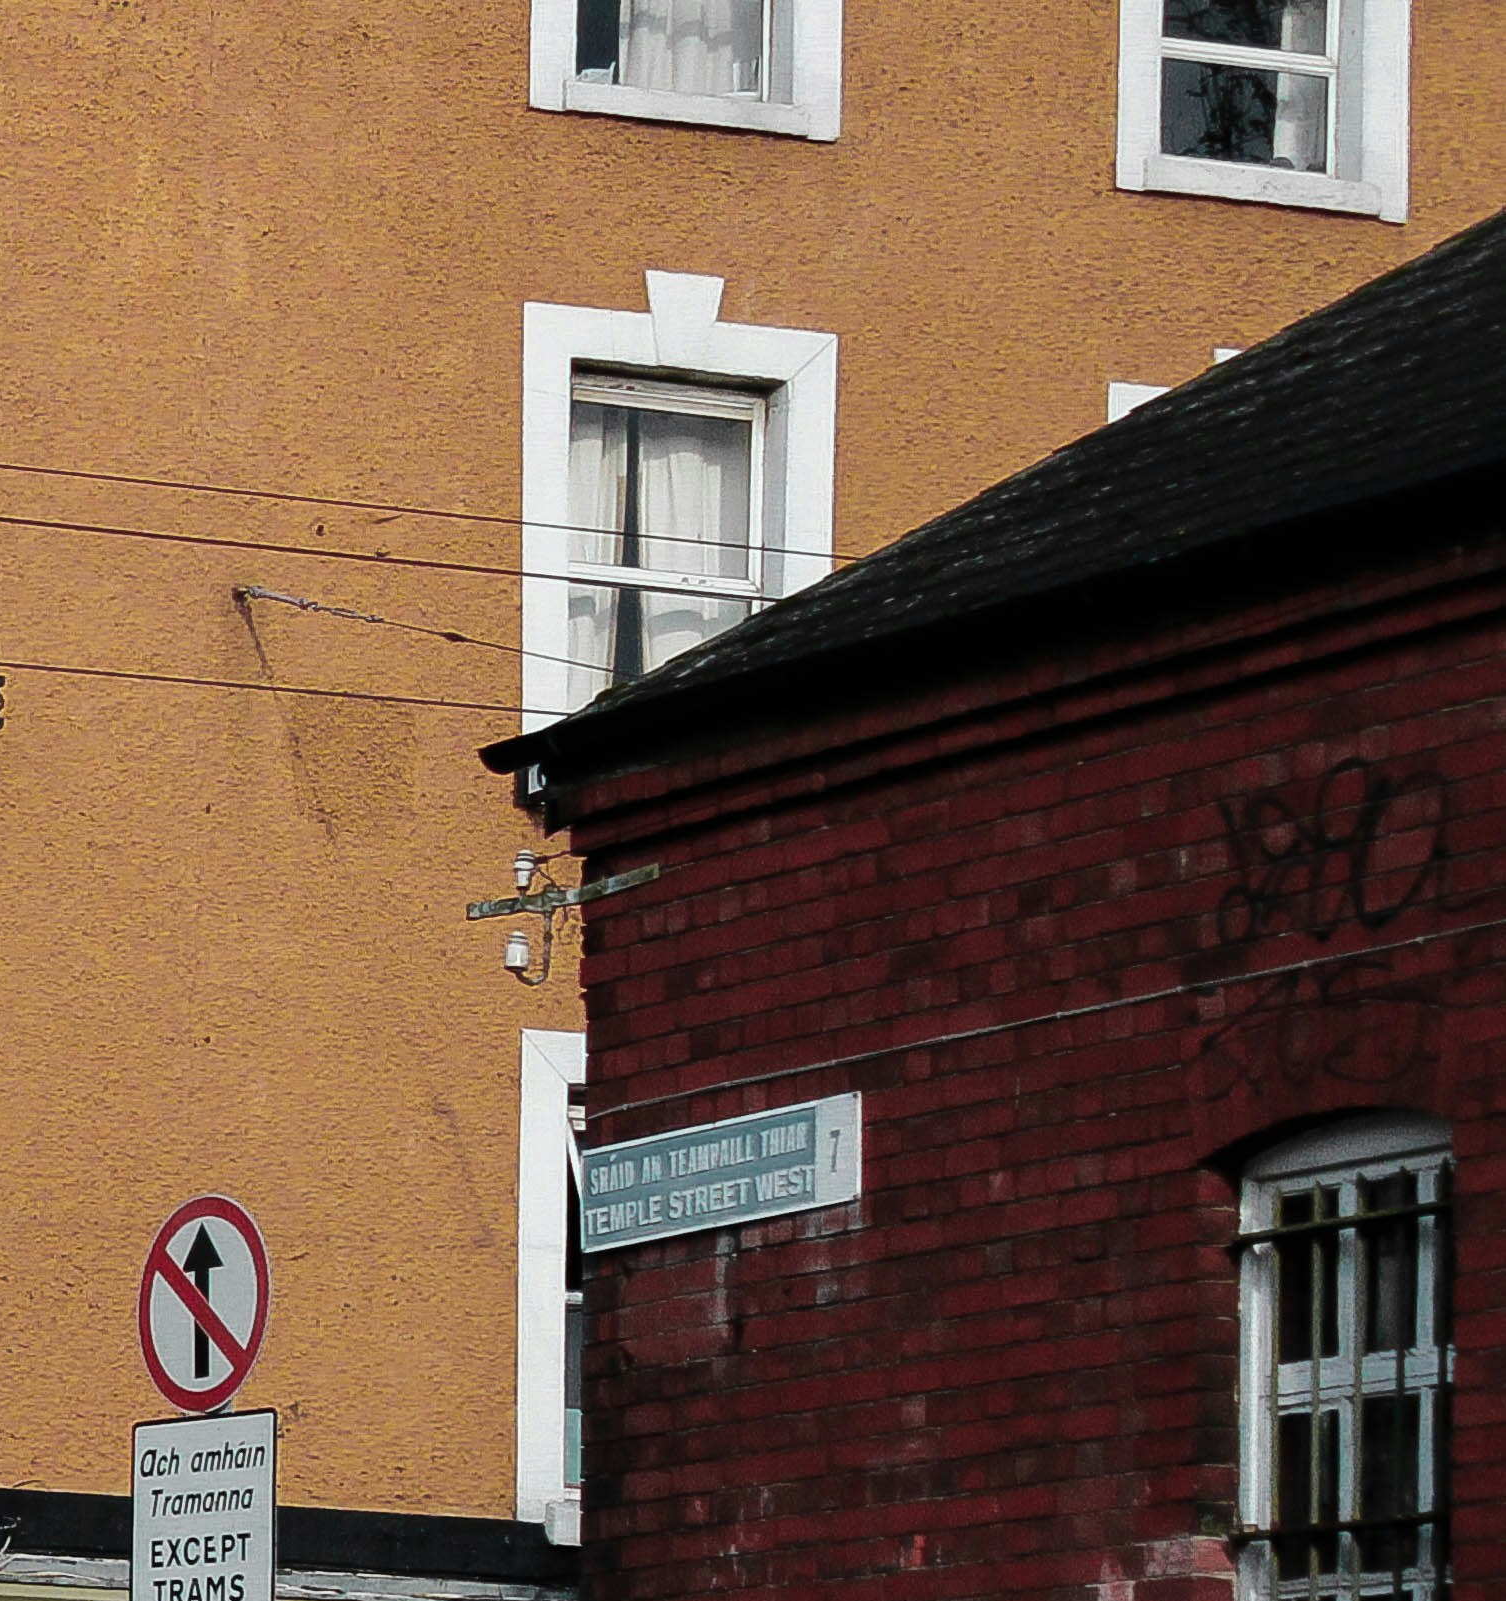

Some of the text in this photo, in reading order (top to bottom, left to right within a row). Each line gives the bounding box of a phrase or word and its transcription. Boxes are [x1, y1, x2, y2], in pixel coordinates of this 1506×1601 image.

[590, 1154, 635, 1196] SRÁID
[642, 1155, 663, 1186] AN
[585, 1164, 815, 1237] TEMPLE STREET WEST
[150, 1487, 254, 1518] Tramanna
[150, 1532, 252, 1568] EXCEPT
